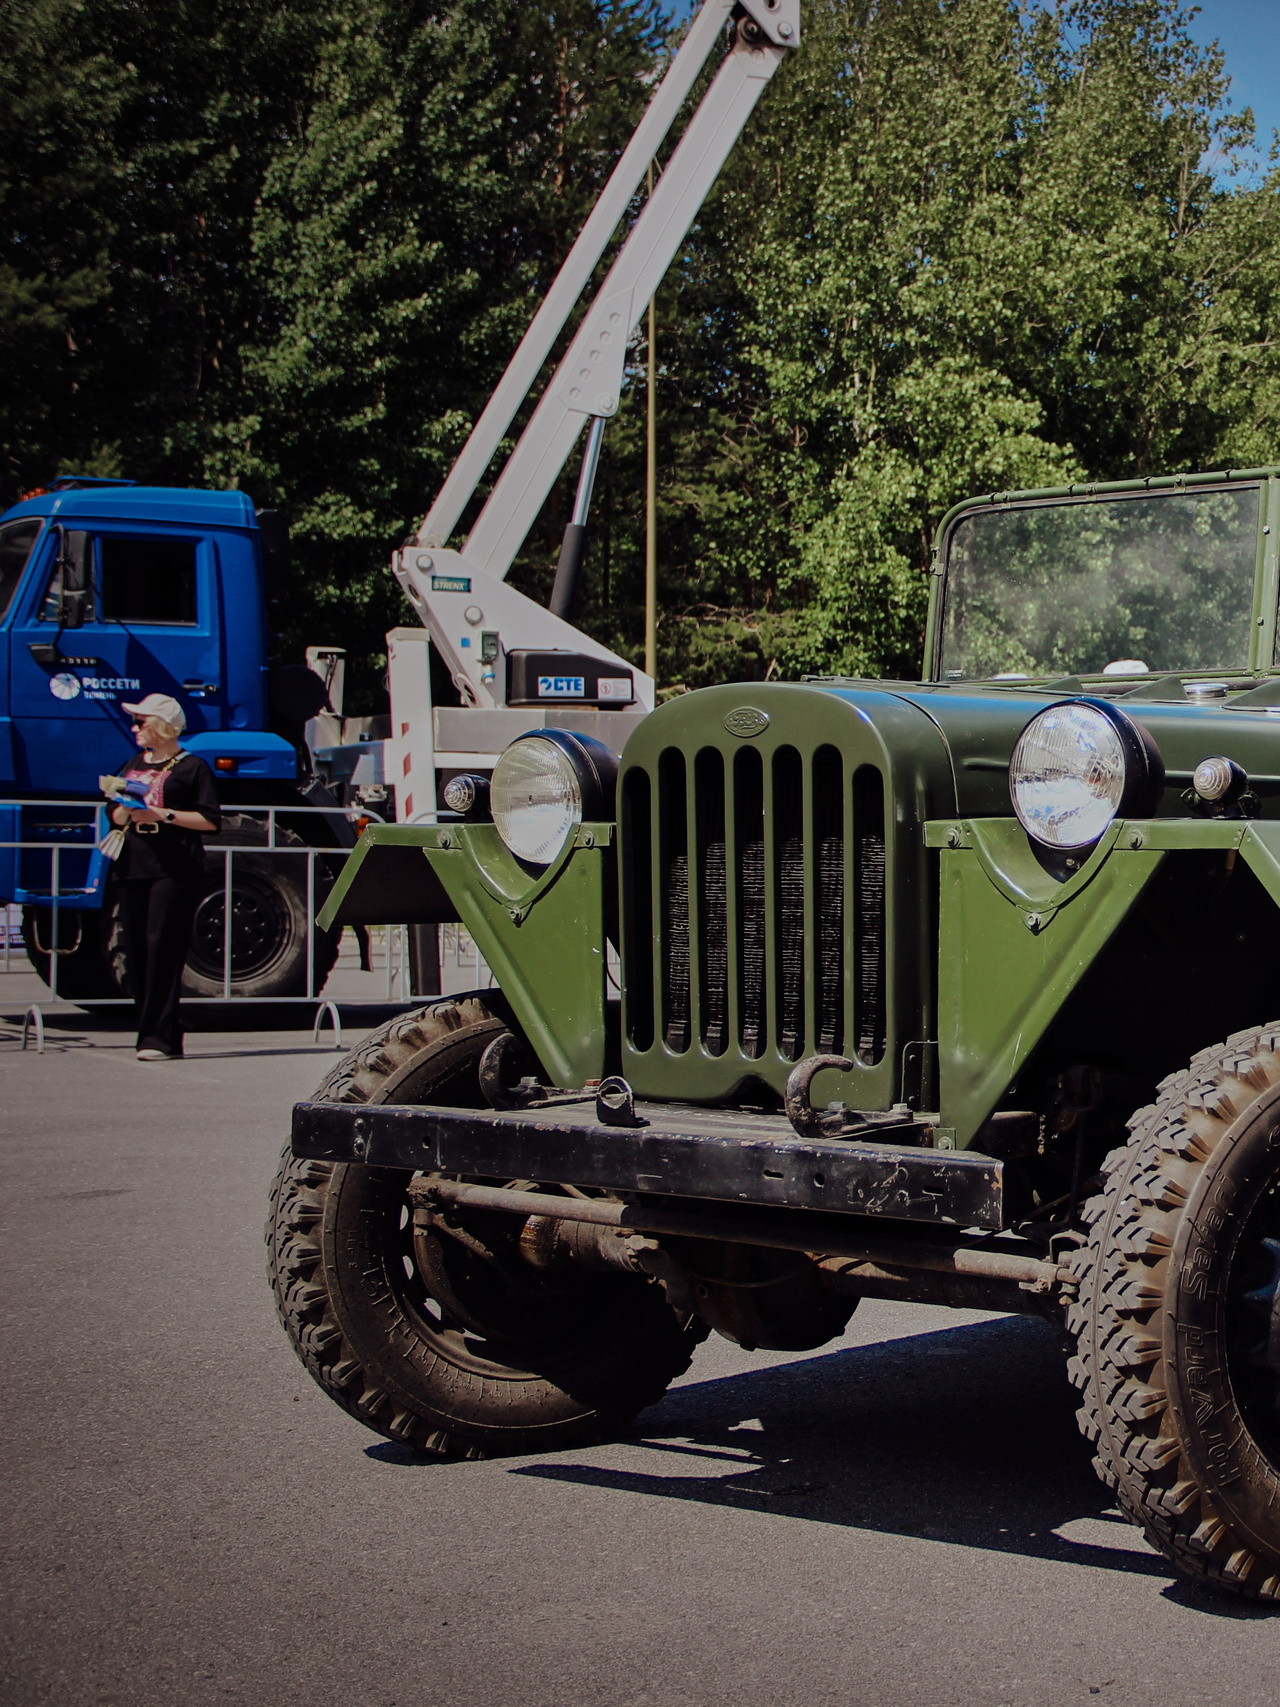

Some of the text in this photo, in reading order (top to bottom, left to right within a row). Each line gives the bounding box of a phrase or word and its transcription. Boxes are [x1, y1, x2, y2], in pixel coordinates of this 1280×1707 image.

[433, 580, 465, 590] STRENX
[82, 677, 140, 690] РОССЕТИ
[553, 677, 582, 691] CTE
[83, 690, 116, 700] ТЮМЕНЬ
[1177, 1170, 1242, 1487] Forward Safari
